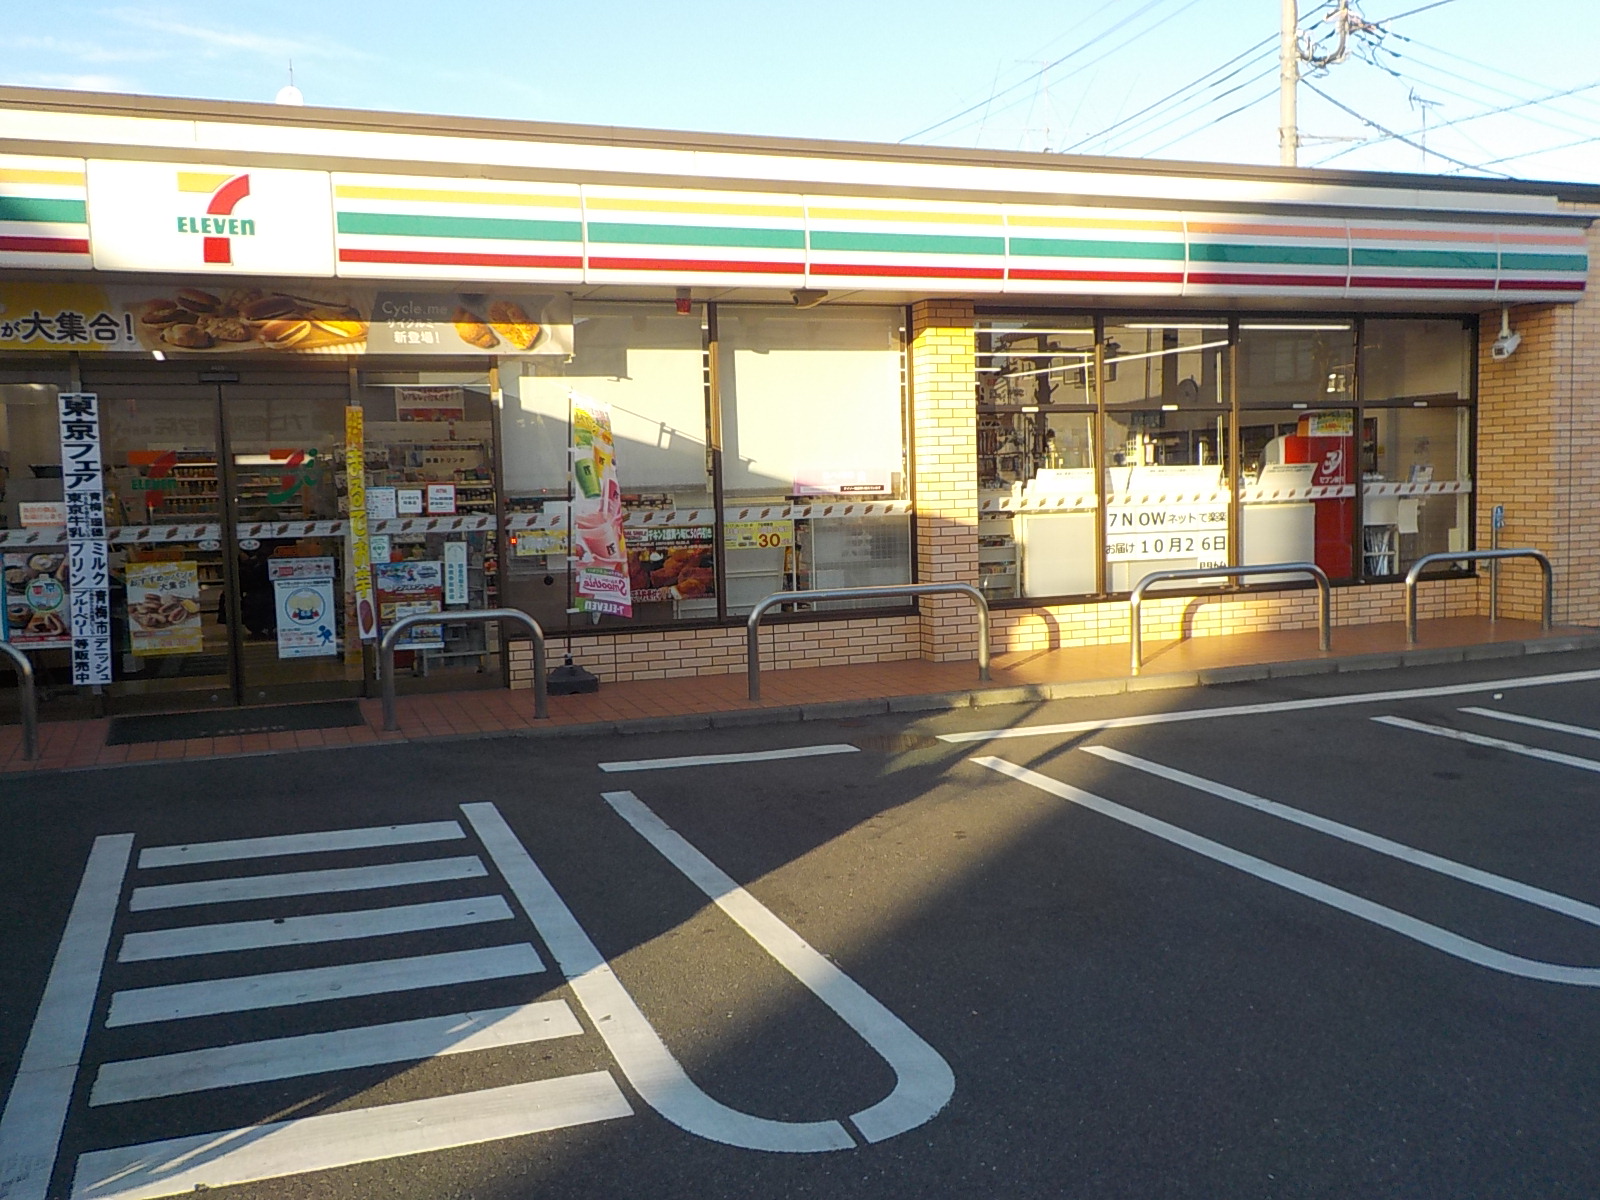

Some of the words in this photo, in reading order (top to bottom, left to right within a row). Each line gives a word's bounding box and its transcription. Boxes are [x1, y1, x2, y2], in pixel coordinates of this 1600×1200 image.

[381, 300, 449, 317] Cycle.me
[387, 317, 455, 329] サイクルミー
[393, 330, 441, 344] 新登場!
[60, 394, 100, 489] 東京フェア
[66, 492, 86, 538] 東京牛乳
[758, 533, 781, 548] 30
[91, 542, 106, 585] ミルク
[95, 590, 109, 635] 青梅市
[74, 638, 90, 683] 等販売中
[94, 638, 111, 681] デニッシュ
